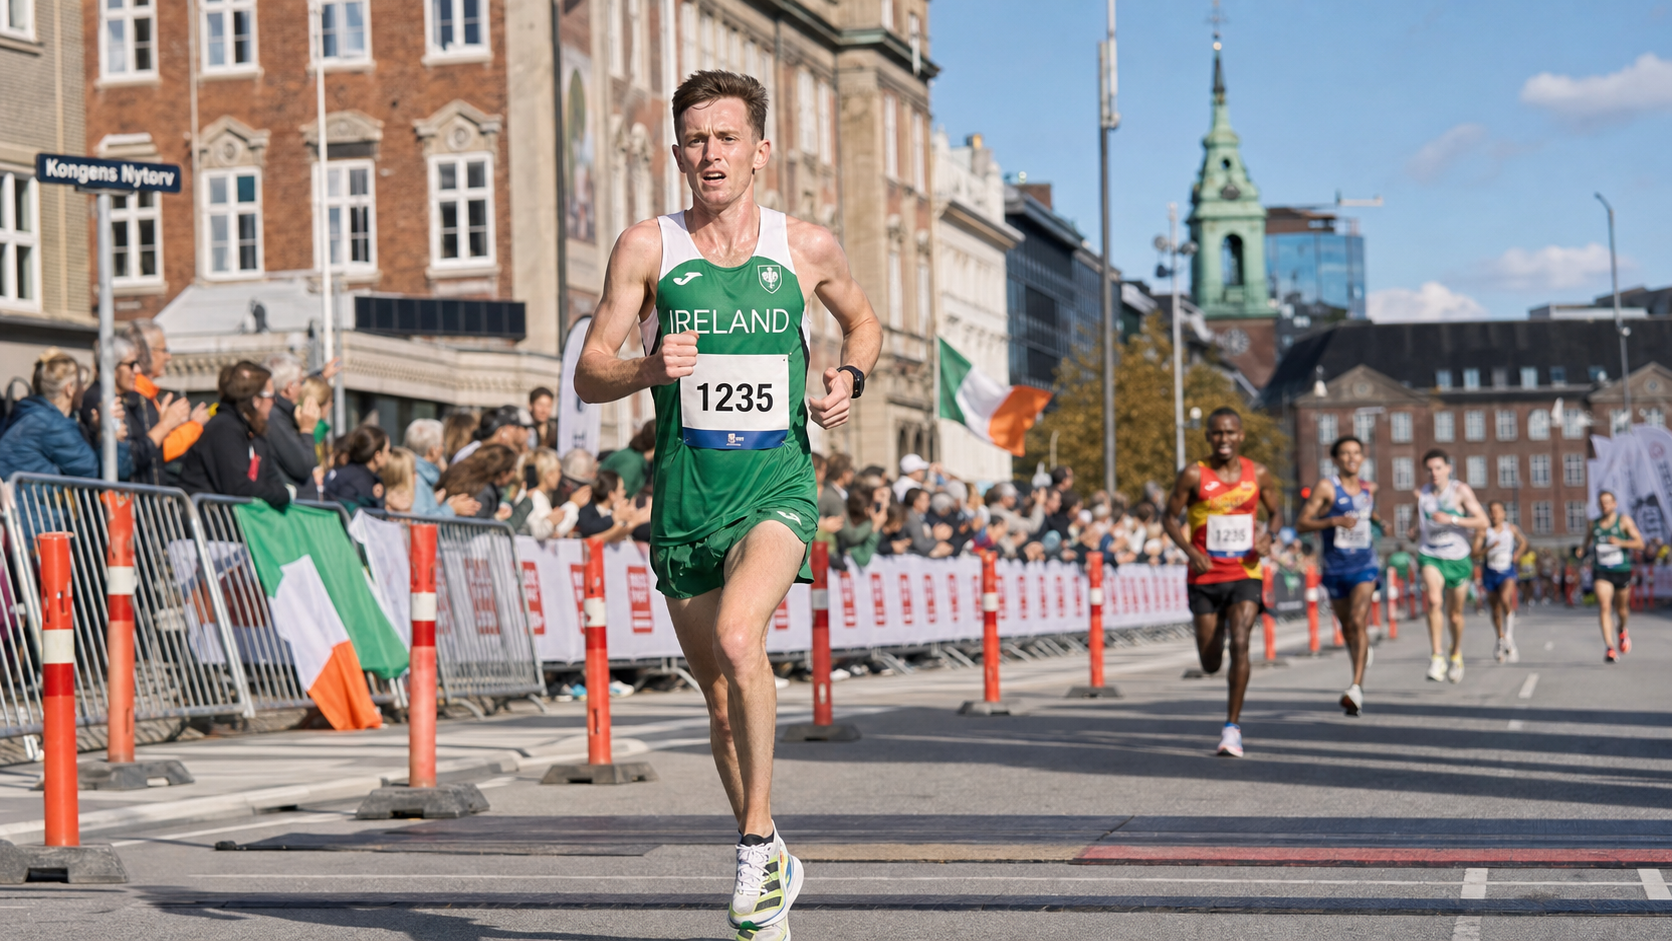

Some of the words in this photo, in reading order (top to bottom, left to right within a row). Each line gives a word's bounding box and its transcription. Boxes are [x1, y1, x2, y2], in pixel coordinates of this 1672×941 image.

[45, 158, 118, 184] Kongens
[121, 164, 175, 188] Nytorv
[669, 308, 790, 335] IRELAND
[696, 382, 774, 413] 1235
